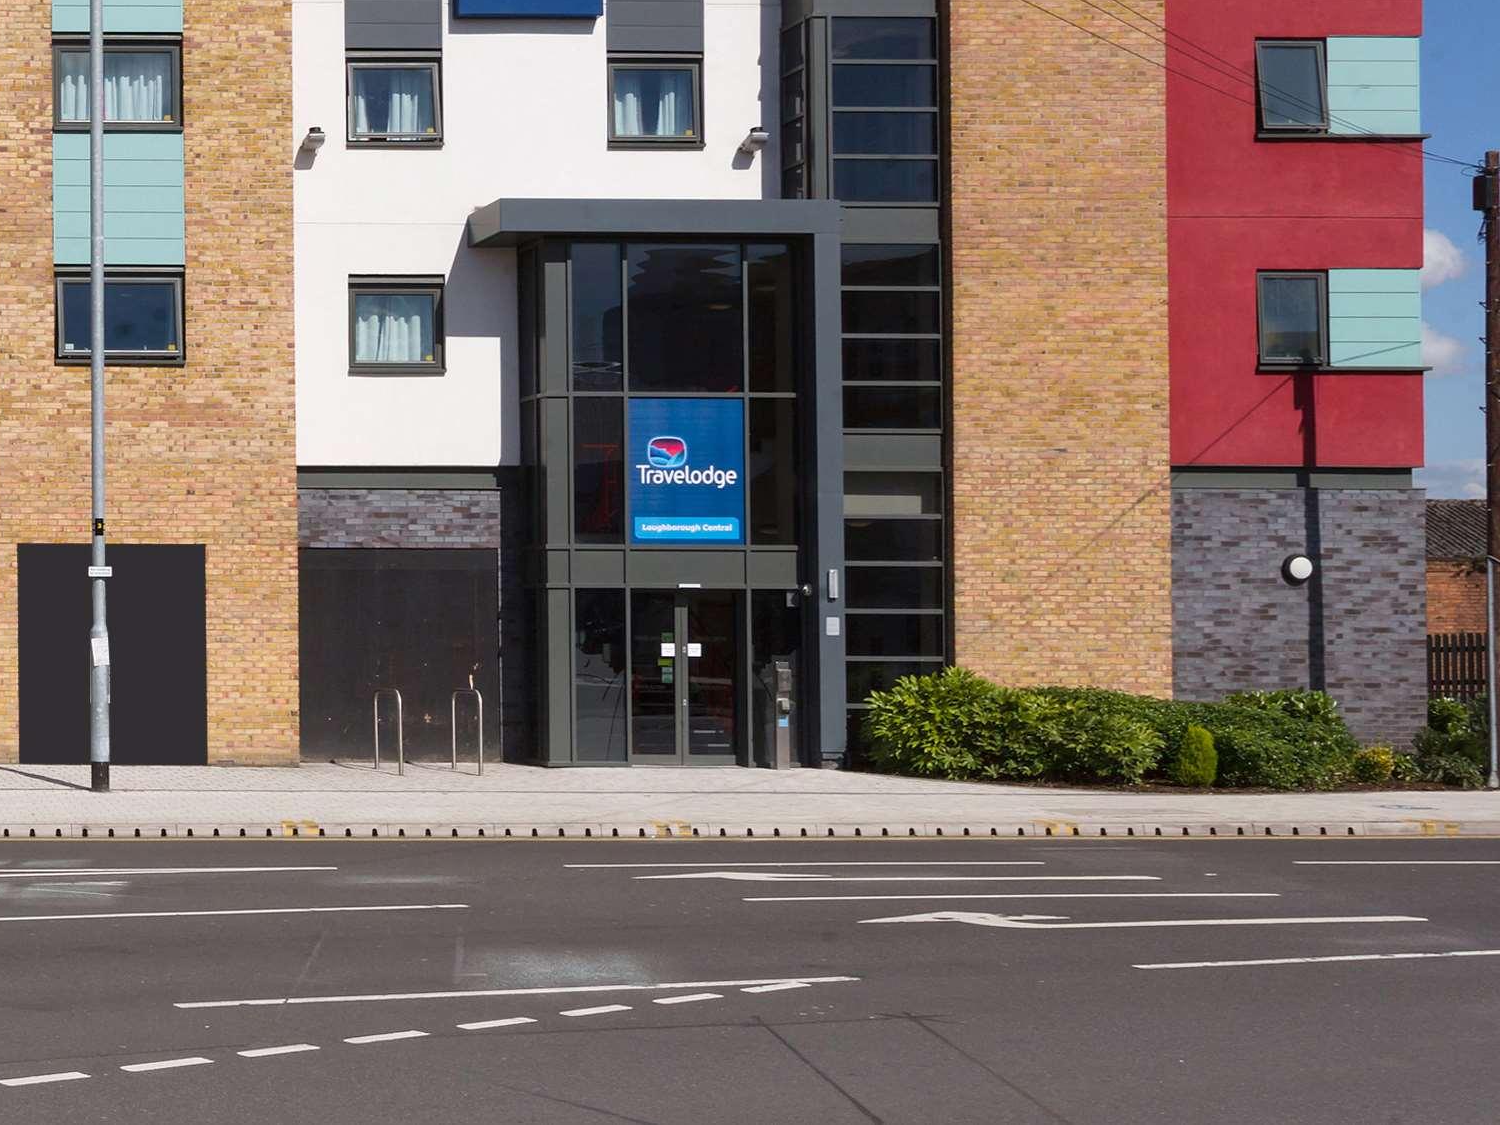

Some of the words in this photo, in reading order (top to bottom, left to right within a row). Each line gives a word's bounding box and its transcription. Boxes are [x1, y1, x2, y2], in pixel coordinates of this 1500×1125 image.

[636, 465, 737, 488] Travelodge
[642, 523, 700, 533] Loughborough
[702, 523, 732, 532] Central
